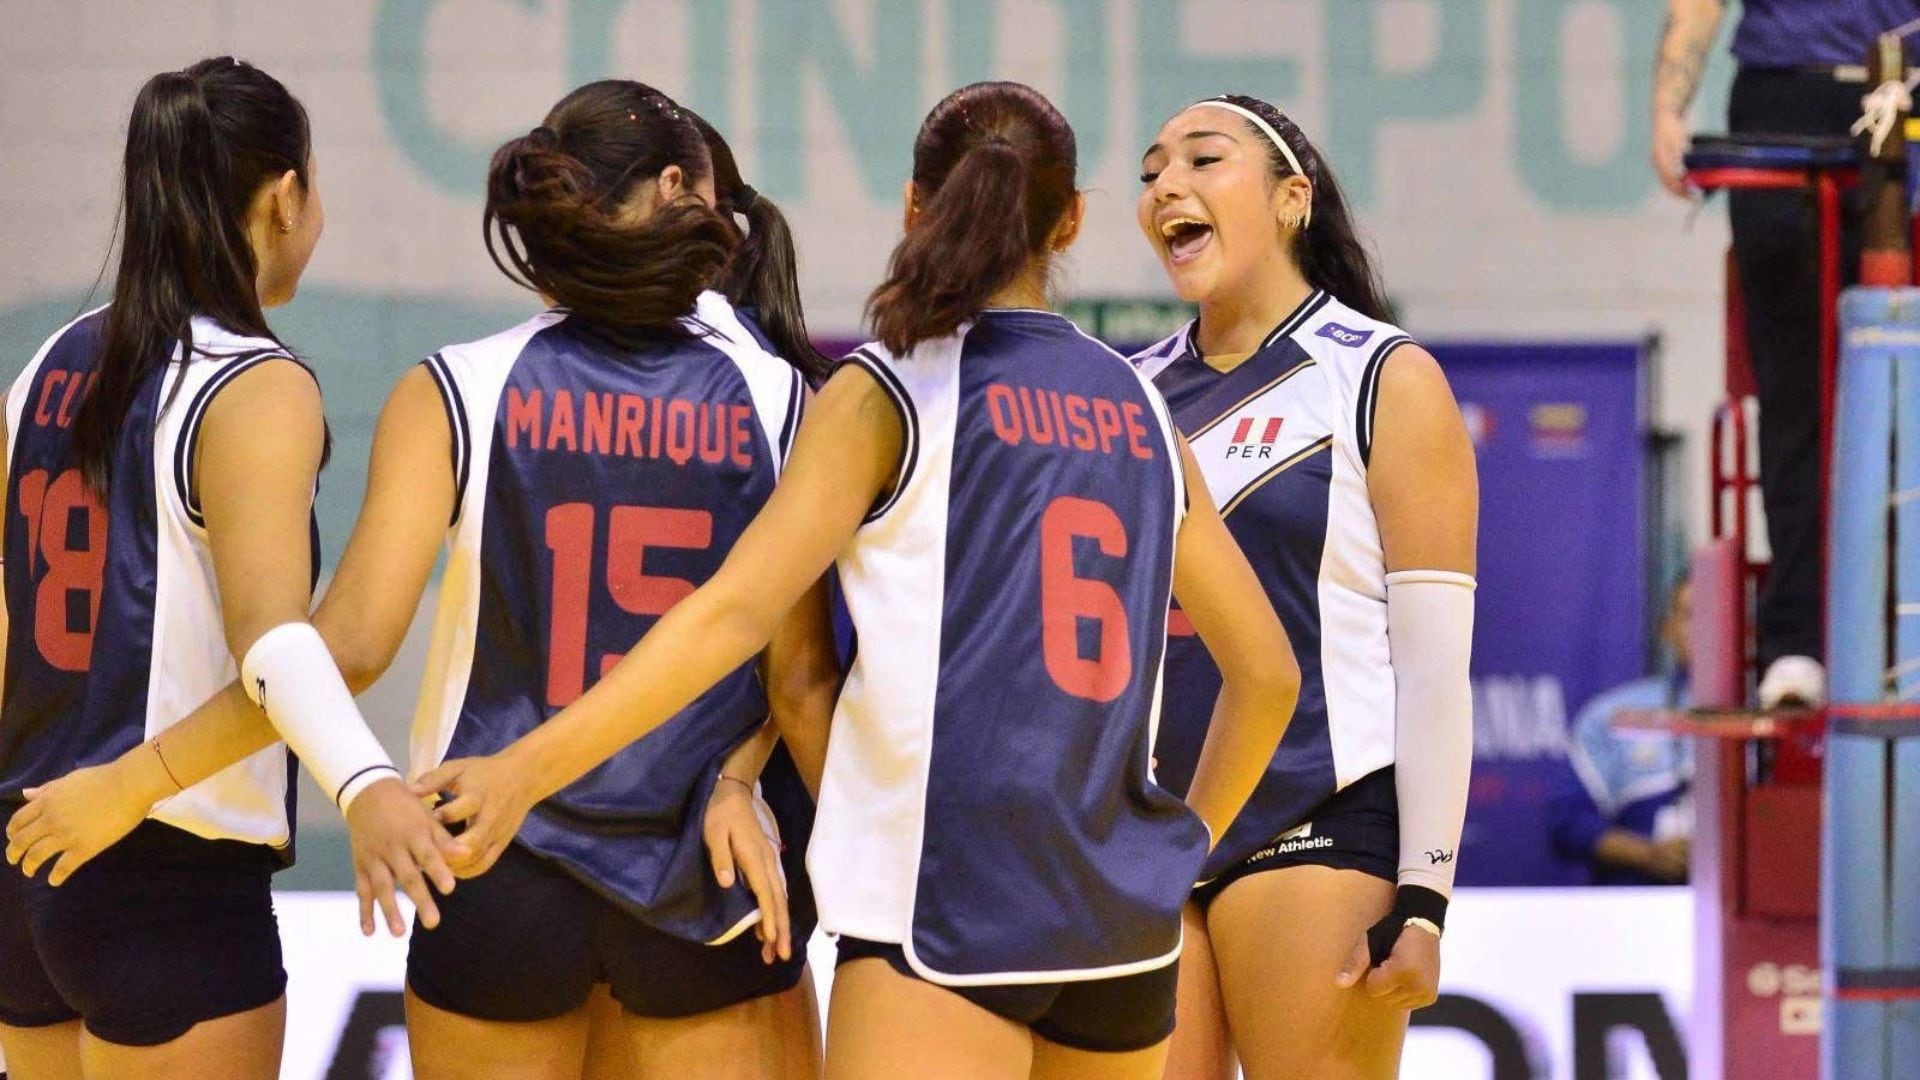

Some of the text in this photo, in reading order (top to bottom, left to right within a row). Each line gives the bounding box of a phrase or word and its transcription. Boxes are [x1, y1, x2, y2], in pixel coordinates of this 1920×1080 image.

[506, 387, 753, 466] MANRIQUE
[986, 383, 1154, 460] QUISPE
[1225, 445, 1272, 459] PER
[18, 467, 109, 672] 18
[545, 502, 713, 707] 15
[1041, 496, 1133, 703] 6
[1277, 835, 1335, 855] Athletic
